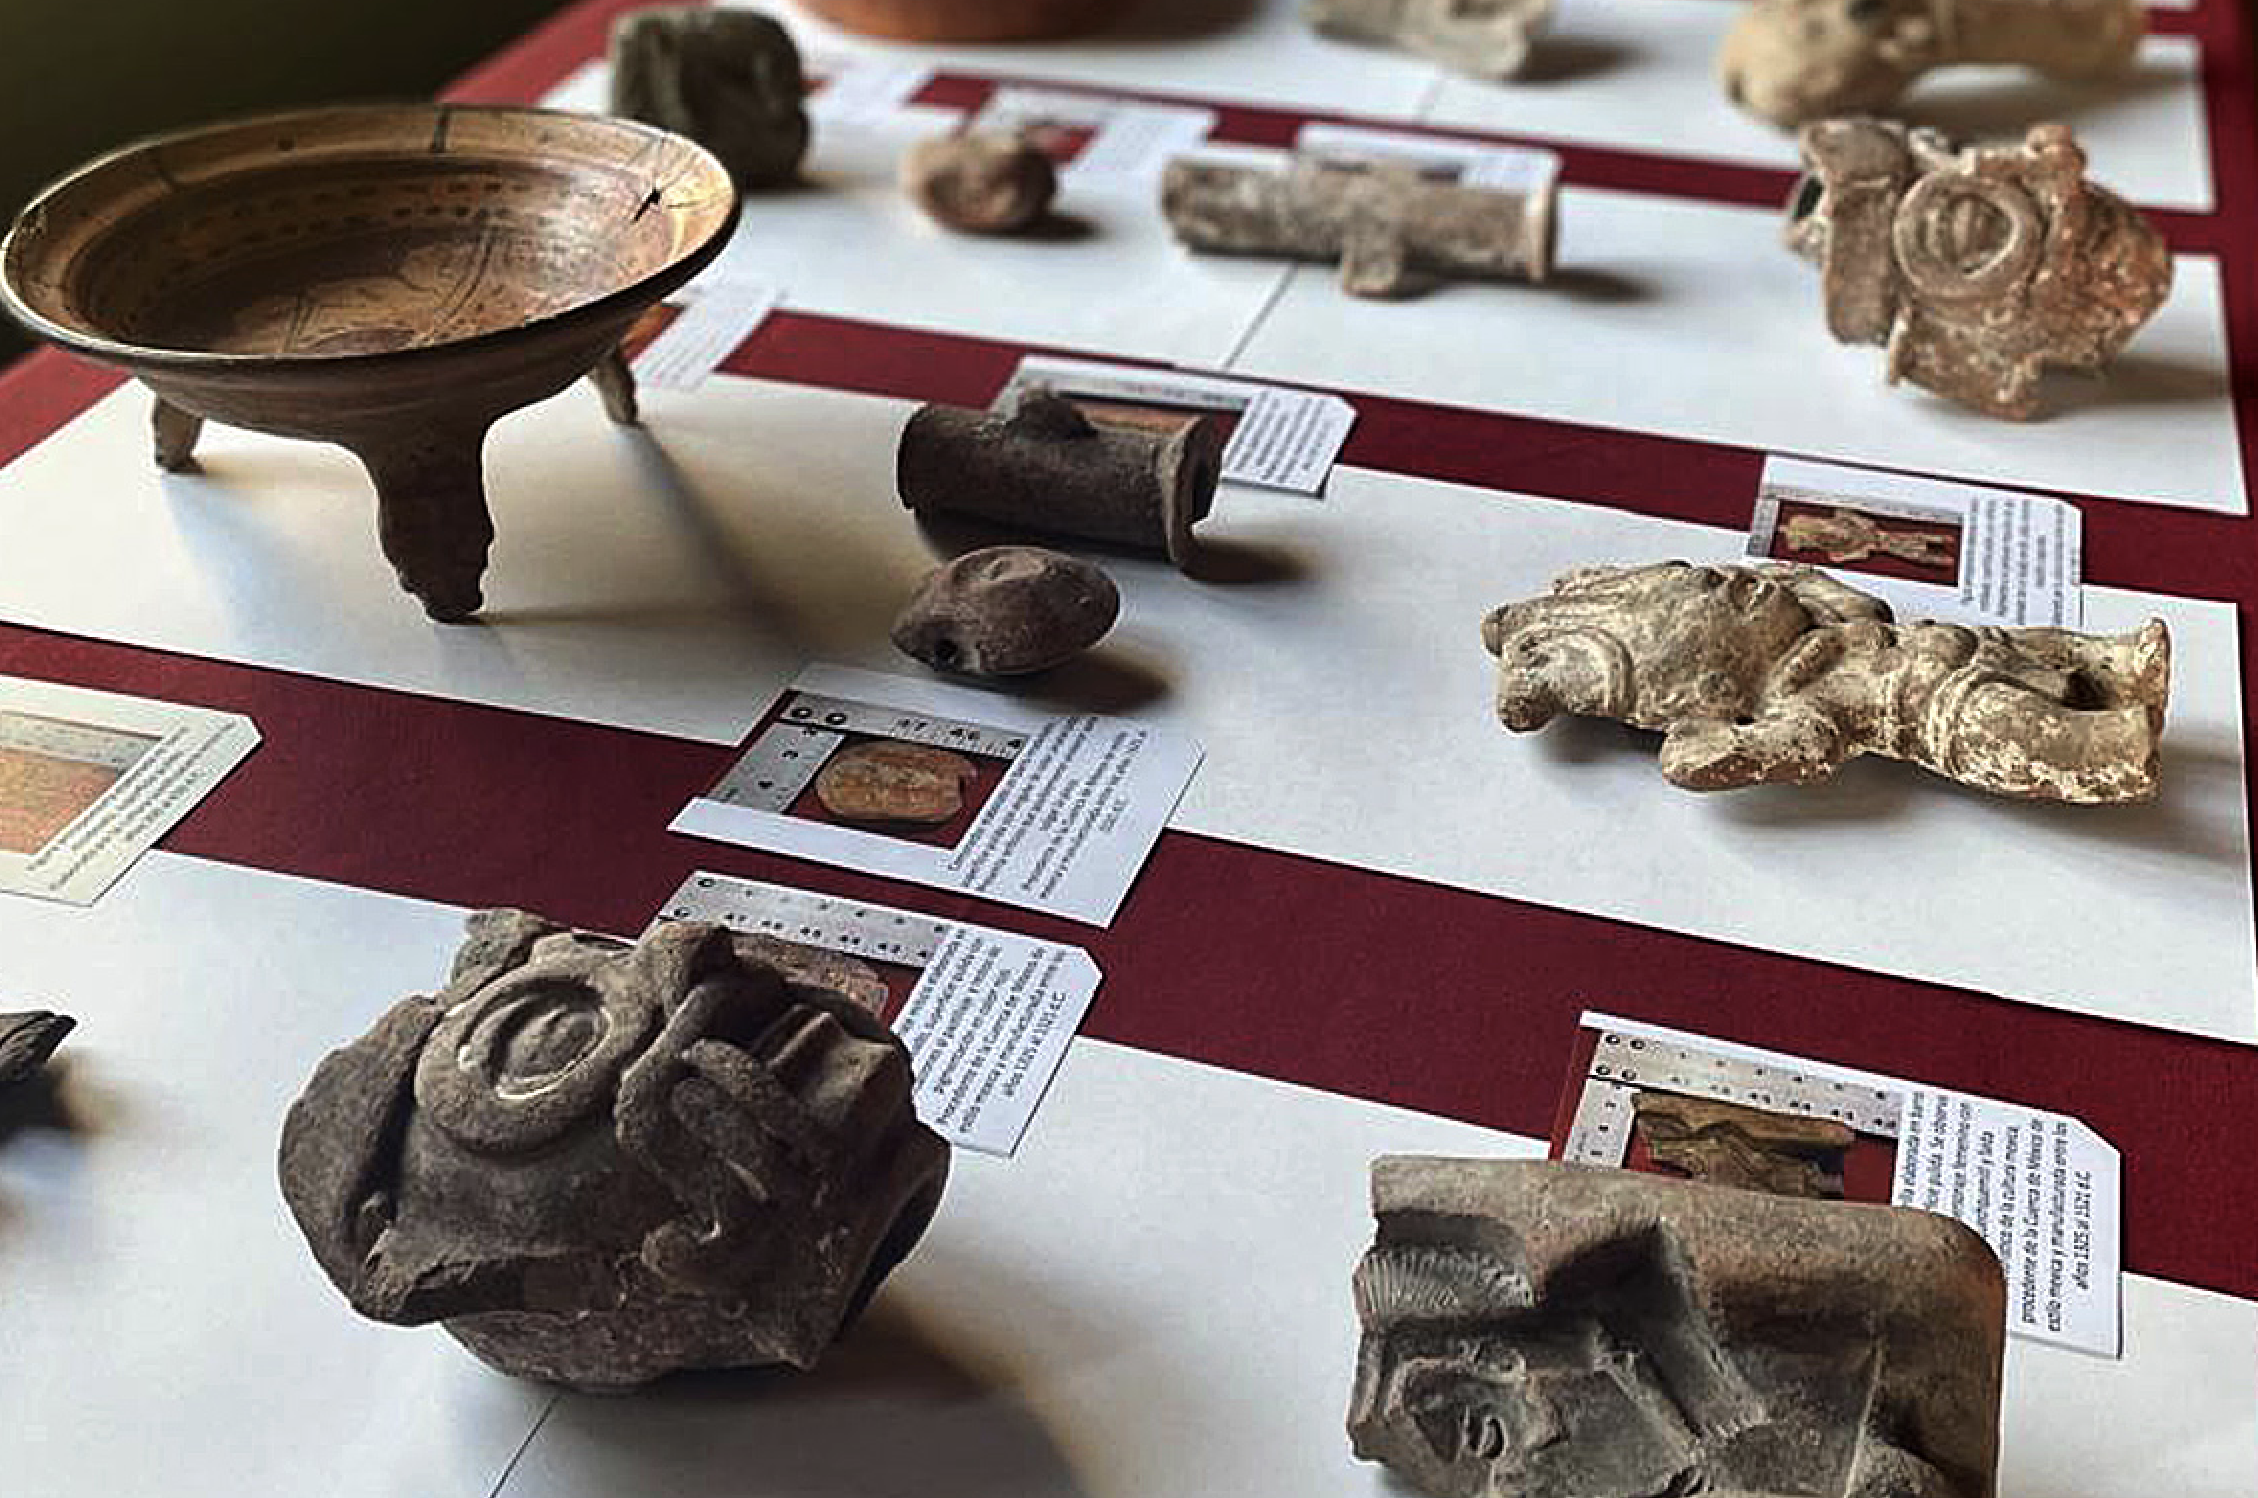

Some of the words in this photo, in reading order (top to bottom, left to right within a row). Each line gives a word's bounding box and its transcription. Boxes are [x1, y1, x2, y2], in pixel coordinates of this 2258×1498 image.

[2026, 1118, 2044, 1133] de
[2025, 1172, 2042, 1188] de
[2022, 1188, 2041, 1227] Cuenca
[2022, 1228, 2039, 1240] la
[2021, 1240, 2039, 1256] de
[2051, 1248, 2067, 1258] y
[2047, 1258, 2064, 1299] mexica
[2073, 1261, 2090, 1290] años
[2021, 1257, 2038, 1324] procedente
[2045, 1300, 2063, 1332] estilo
